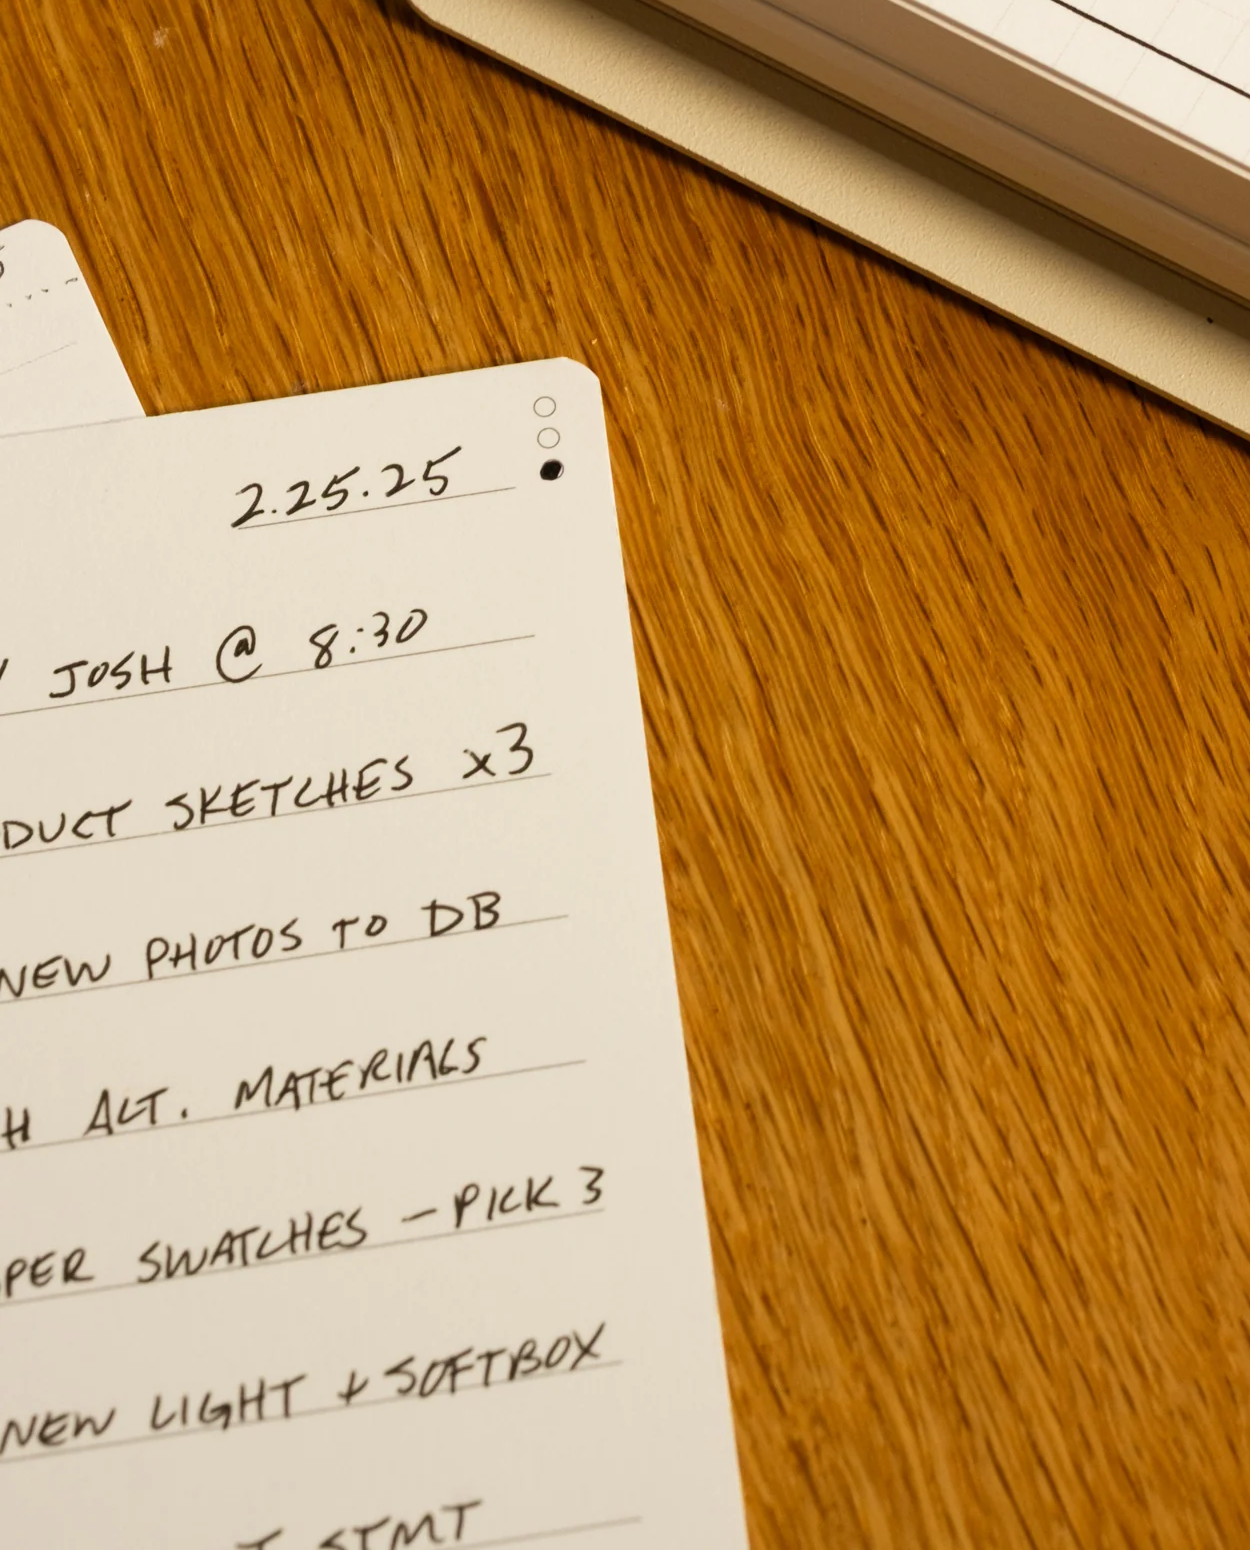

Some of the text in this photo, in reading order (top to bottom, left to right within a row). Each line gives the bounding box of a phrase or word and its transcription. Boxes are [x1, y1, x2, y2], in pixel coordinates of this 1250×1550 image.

[230, 445, 463, 529] 2.25.25
[49, 608, 429, 699] JOSH @ 8:30
[165, 755, 415, 831] SKETCHES
[0, 953, 111, 998] NEW
[145, 918, 303, 980] PHOTOS
[421, 891, 501, 937] DB
[83, 1087, 189, 1137] ALT.
[234, 1037, 489, 1110] MATERIALS
[137, 1207, 369, 1284] SWATCHES
[453, 1176, 561, 1228] PICK
[579, 1166, 605, 1205] 3
[0, 1407, 117, 1450] NEW
[150, 1374, 307, 1432] LIGHT
[384, 1322, 606, 1397] SOFTBOX
